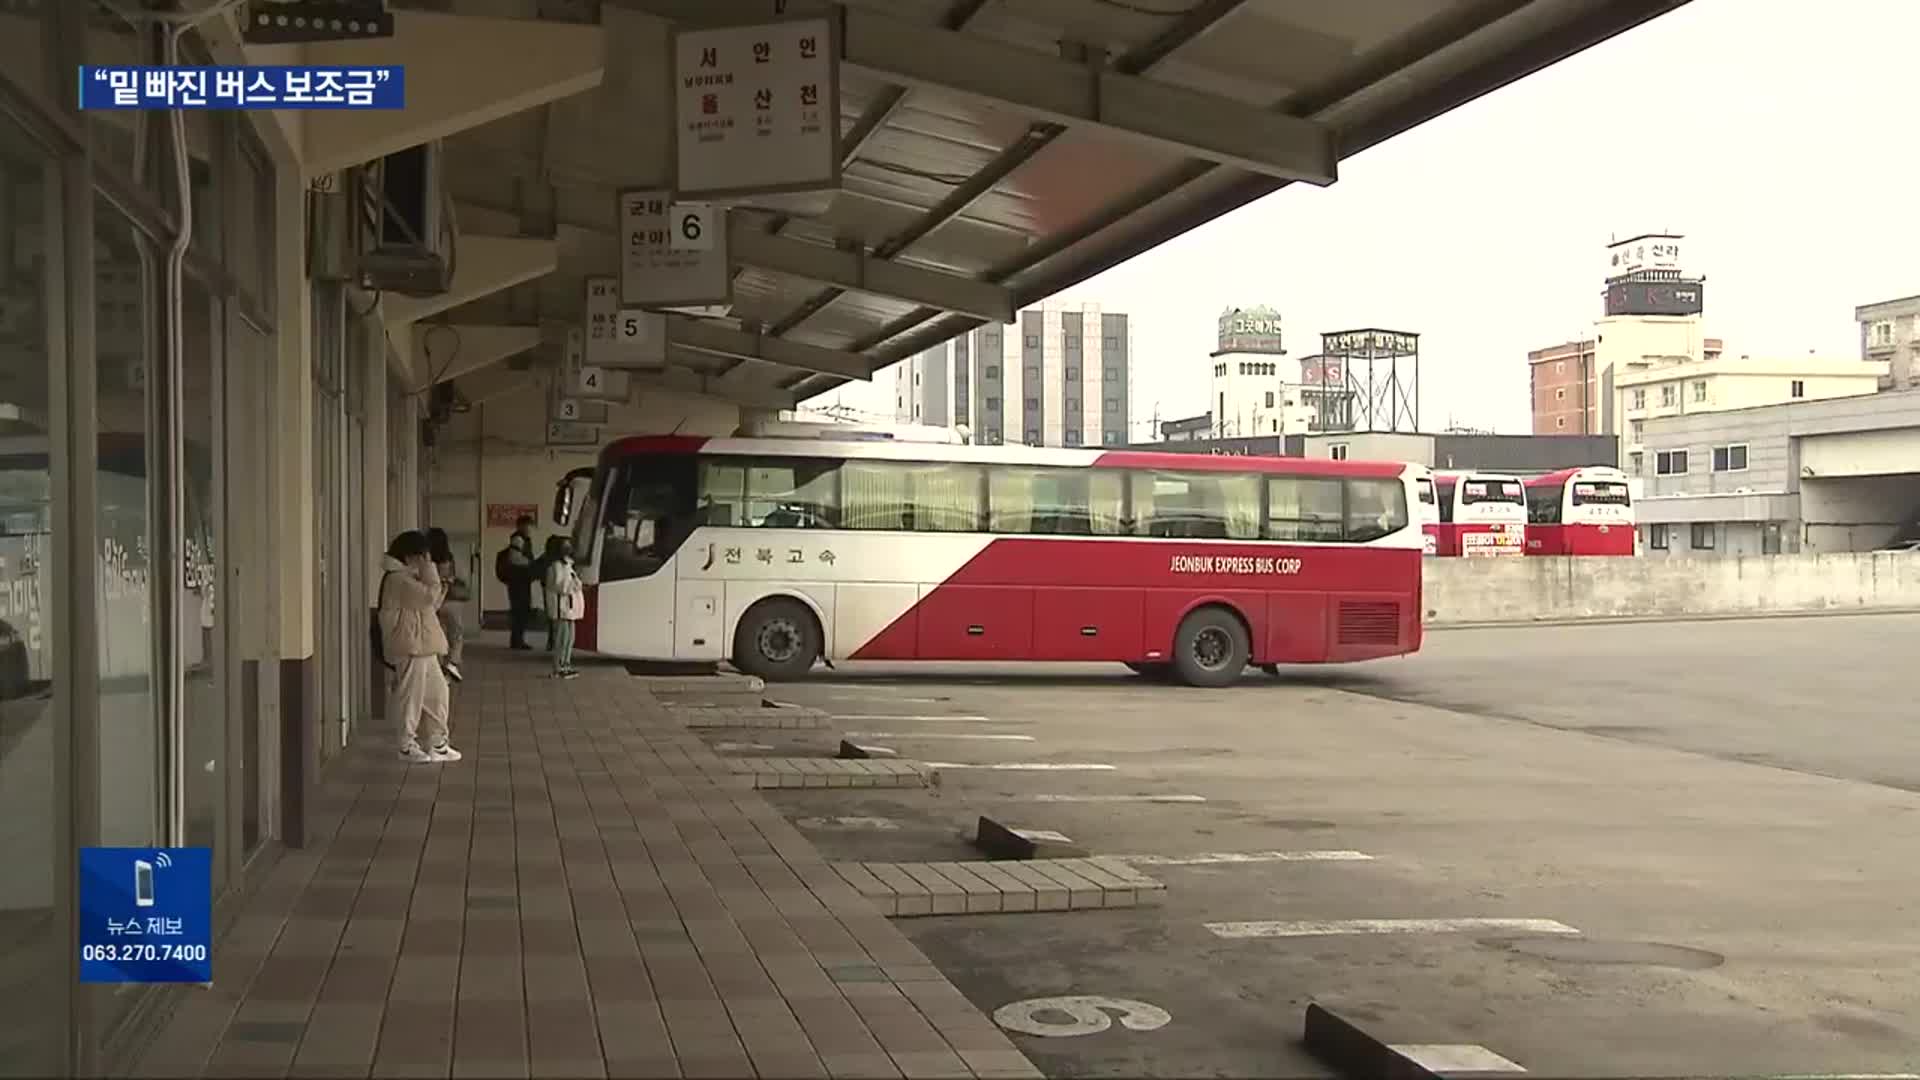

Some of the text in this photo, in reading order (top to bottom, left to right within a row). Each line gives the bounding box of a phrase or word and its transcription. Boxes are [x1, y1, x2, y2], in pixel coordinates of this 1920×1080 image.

[681, 213, 701, 240] 6
[624, 318, 639, 337] 5
[586, 373, 597, 388] 4
[564, 403, 574, 417] 3
[1170, 555, 1302, 575] JEONBUK EXPRESS BUS CORP
